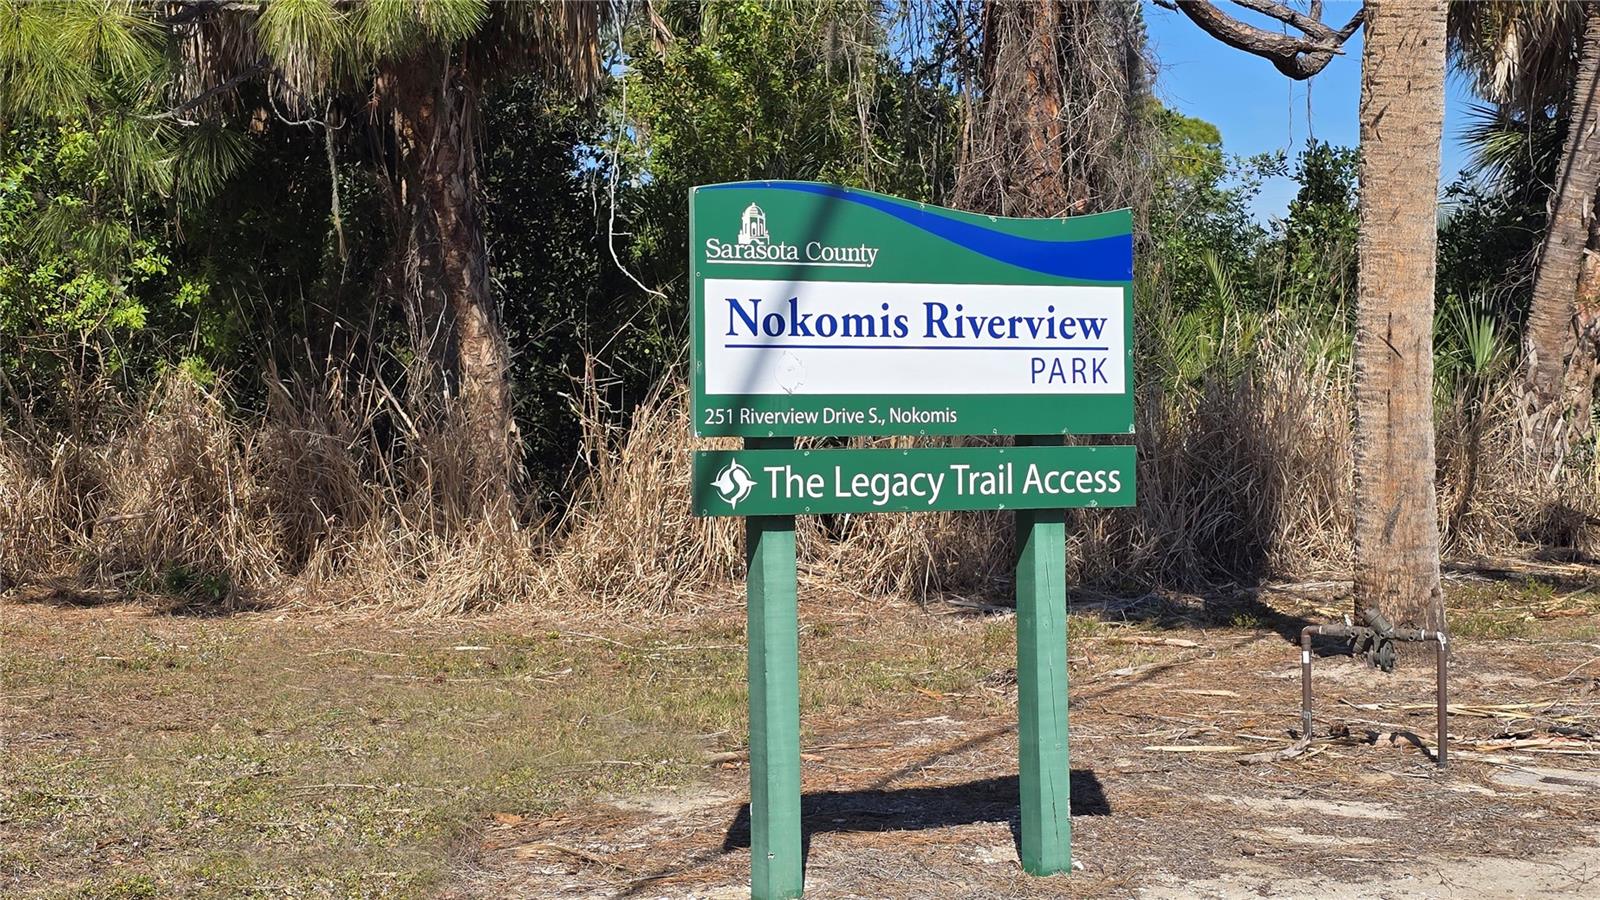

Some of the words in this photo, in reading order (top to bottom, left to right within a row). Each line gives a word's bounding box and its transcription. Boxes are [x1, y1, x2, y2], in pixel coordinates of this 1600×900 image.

[705, 238, 800, 261] Sarasota
[805, 242, 879, 268] County
[725, 297, 909, 338] Nokomis
[923, 302, 1108, 340] Riverview
[1031, 357, 1108, 384] PARK
[704, 408, 734, 425] 251
[740, 407, 818, 424] Riverview
[823, 407, 864, 424] Drive
[868, 407, 885, 426] S.,
[889, 406, 957, 424] Nokomis
[763, 464, 825, 499] The
[835, 465, 945, 506] Legacy
[950, 462, 1013, 496] Trail
[1022, 463, 1121, 495] Access
